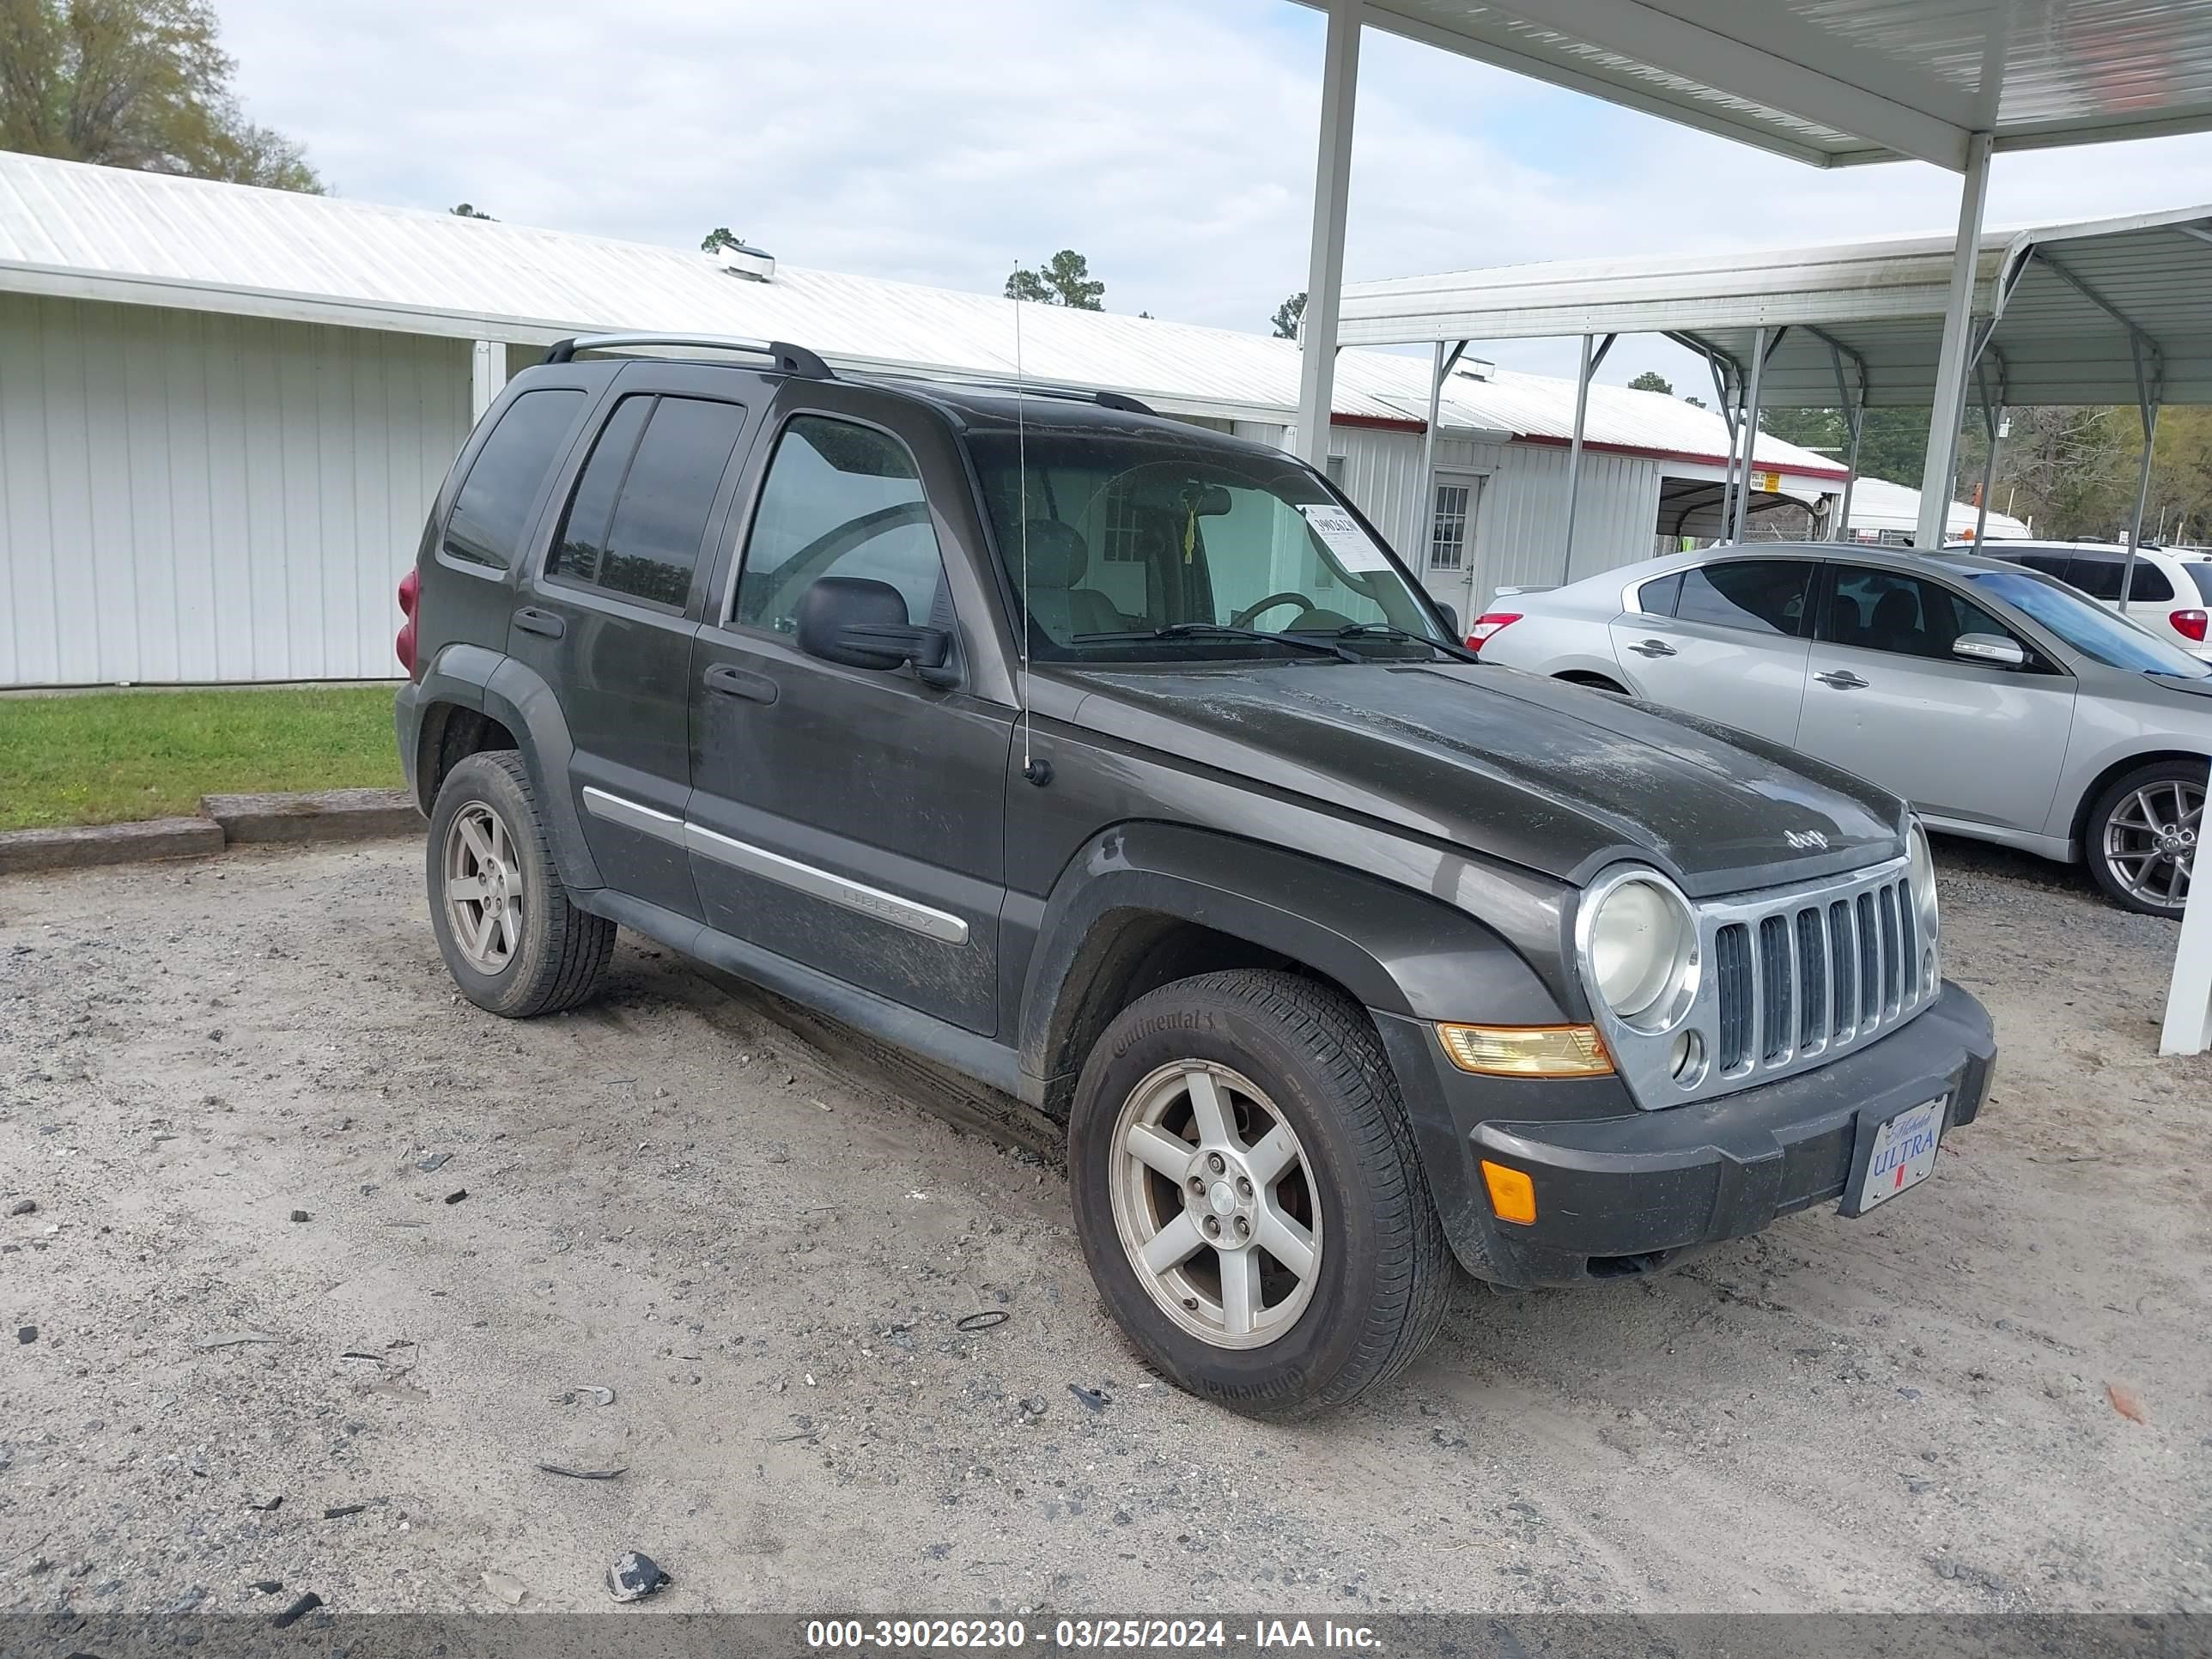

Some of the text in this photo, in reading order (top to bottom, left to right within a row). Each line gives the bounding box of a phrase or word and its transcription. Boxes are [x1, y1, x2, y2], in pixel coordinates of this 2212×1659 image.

[1784, 830, 1828, 849] Jeep
[843, 892, 933, 928] LIBERTY
[1112, 1010, 1200, 1058] Continental
[1875, 1128, 1933, 1176] ULTRA
